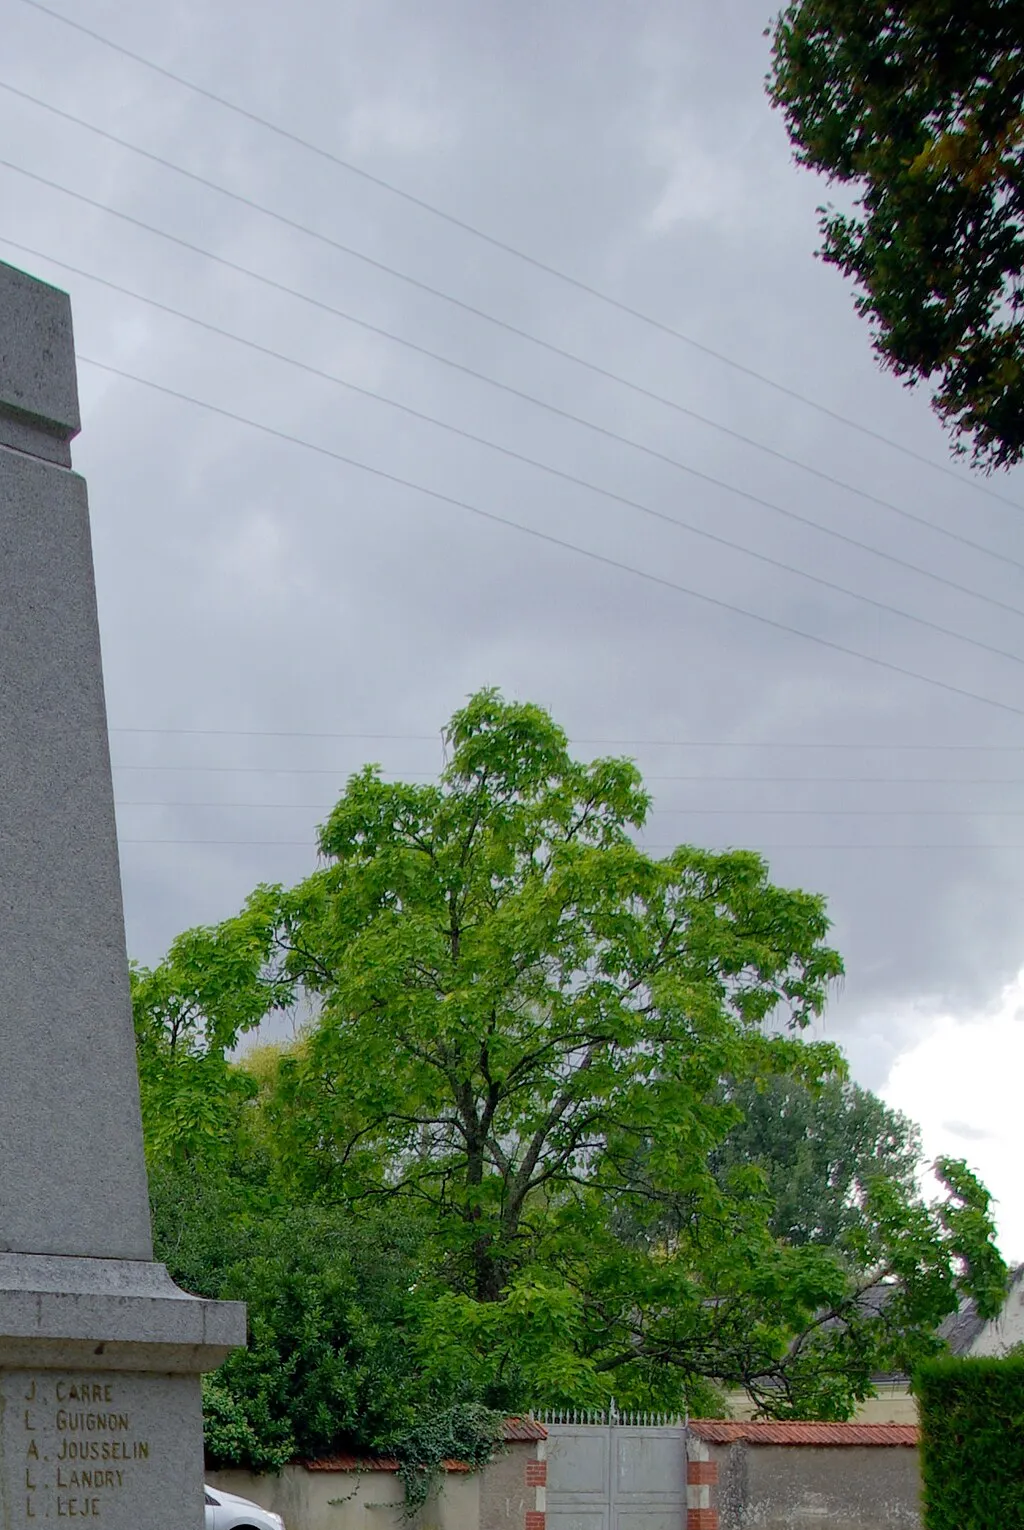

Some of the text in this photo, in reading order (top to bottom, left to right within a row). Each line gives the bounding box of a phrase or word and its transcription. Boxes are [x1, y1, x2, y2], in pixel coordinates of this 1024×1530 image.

[25, 1380, 47, 1405] J.
[25, 1409, 129, 1431] L. GUIGNON
[26, 1439, 149, 1461] A. JOUSSELIN
[26, 1467, 124, 1491] L. LANDRY
[27, 1496, 49, 1517] L.
